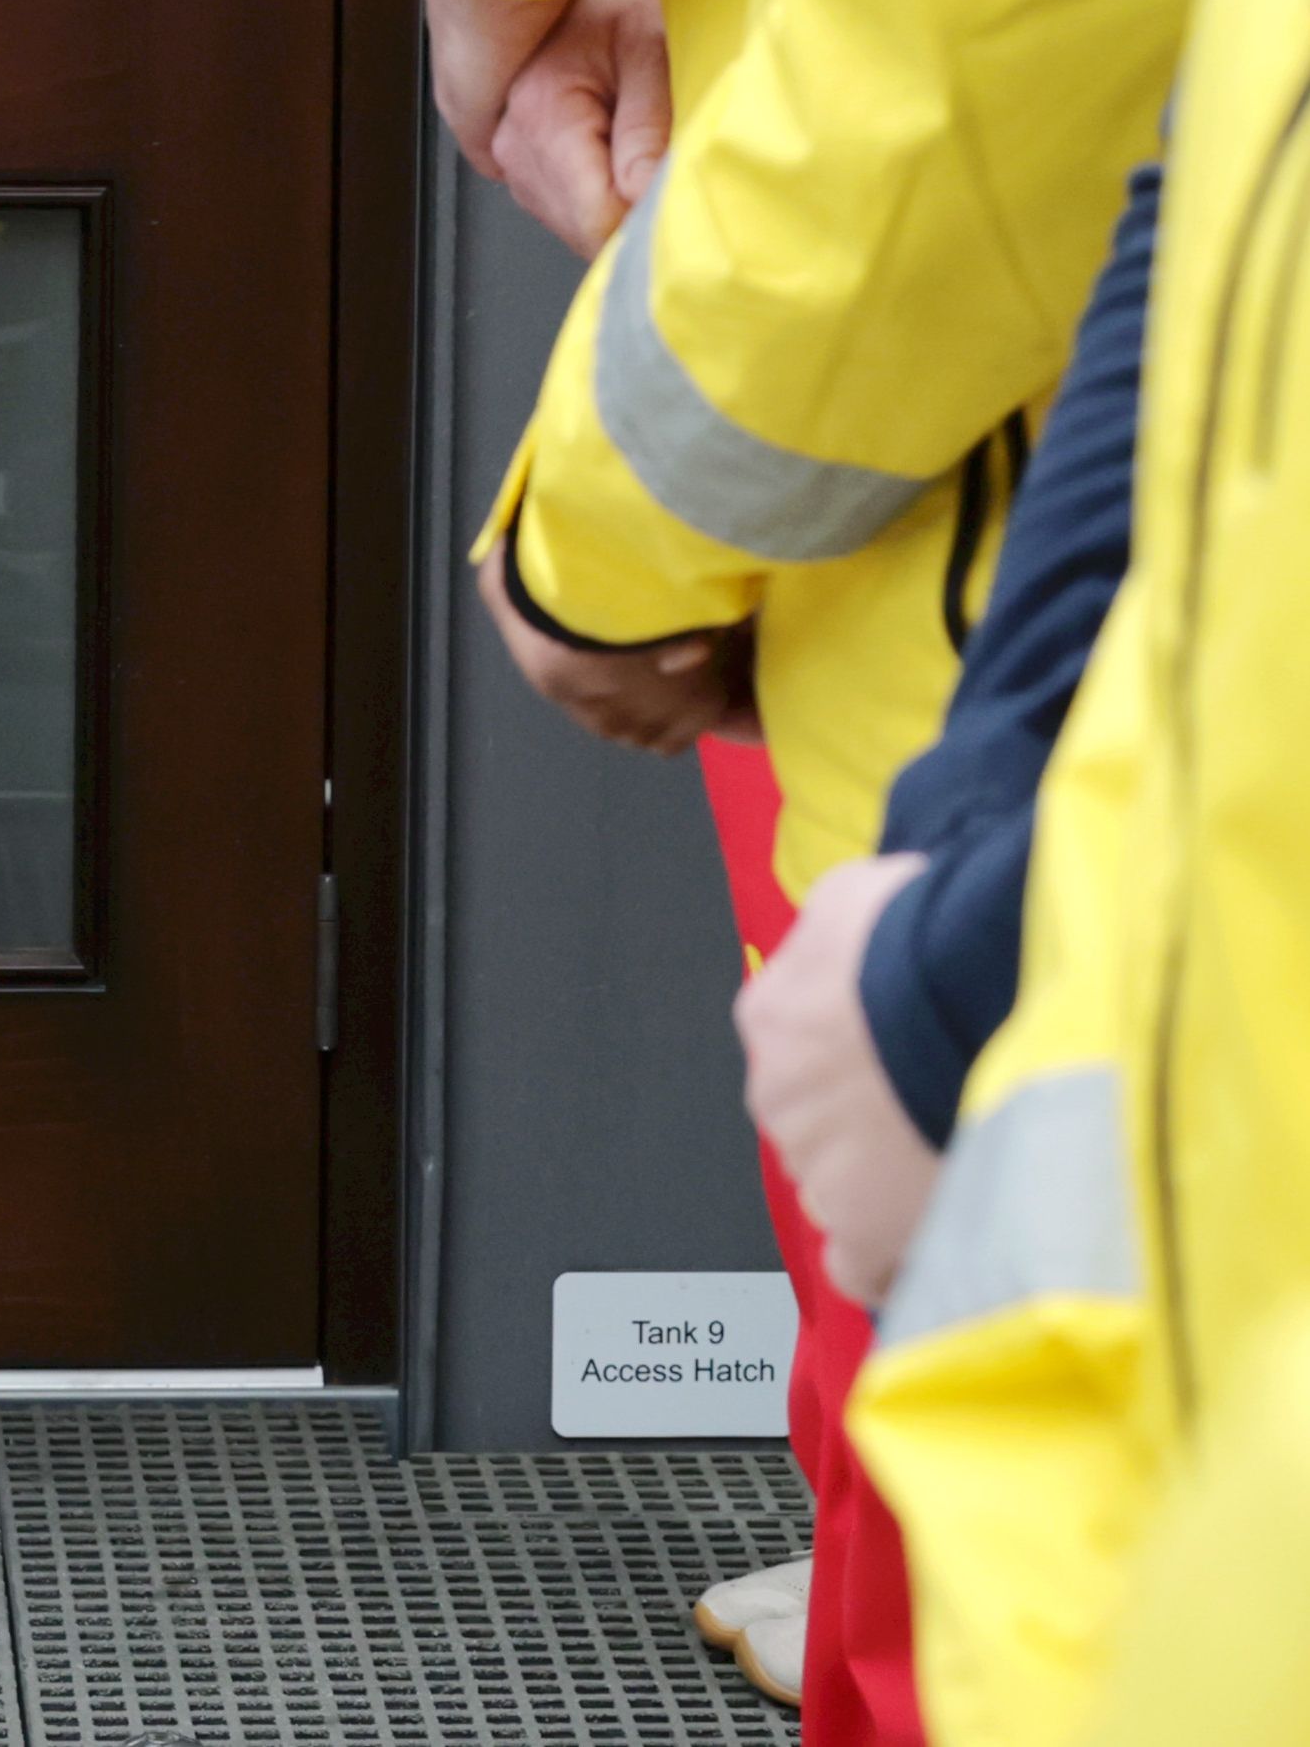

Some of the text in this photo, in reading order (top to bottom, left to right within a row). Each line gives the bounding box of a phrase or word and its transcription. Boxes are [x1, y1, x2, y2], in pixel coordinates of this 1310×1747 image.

[632, 1320, 726, 1345] Tank 9
[580, 1358, 776, 1383] Access Hatch
